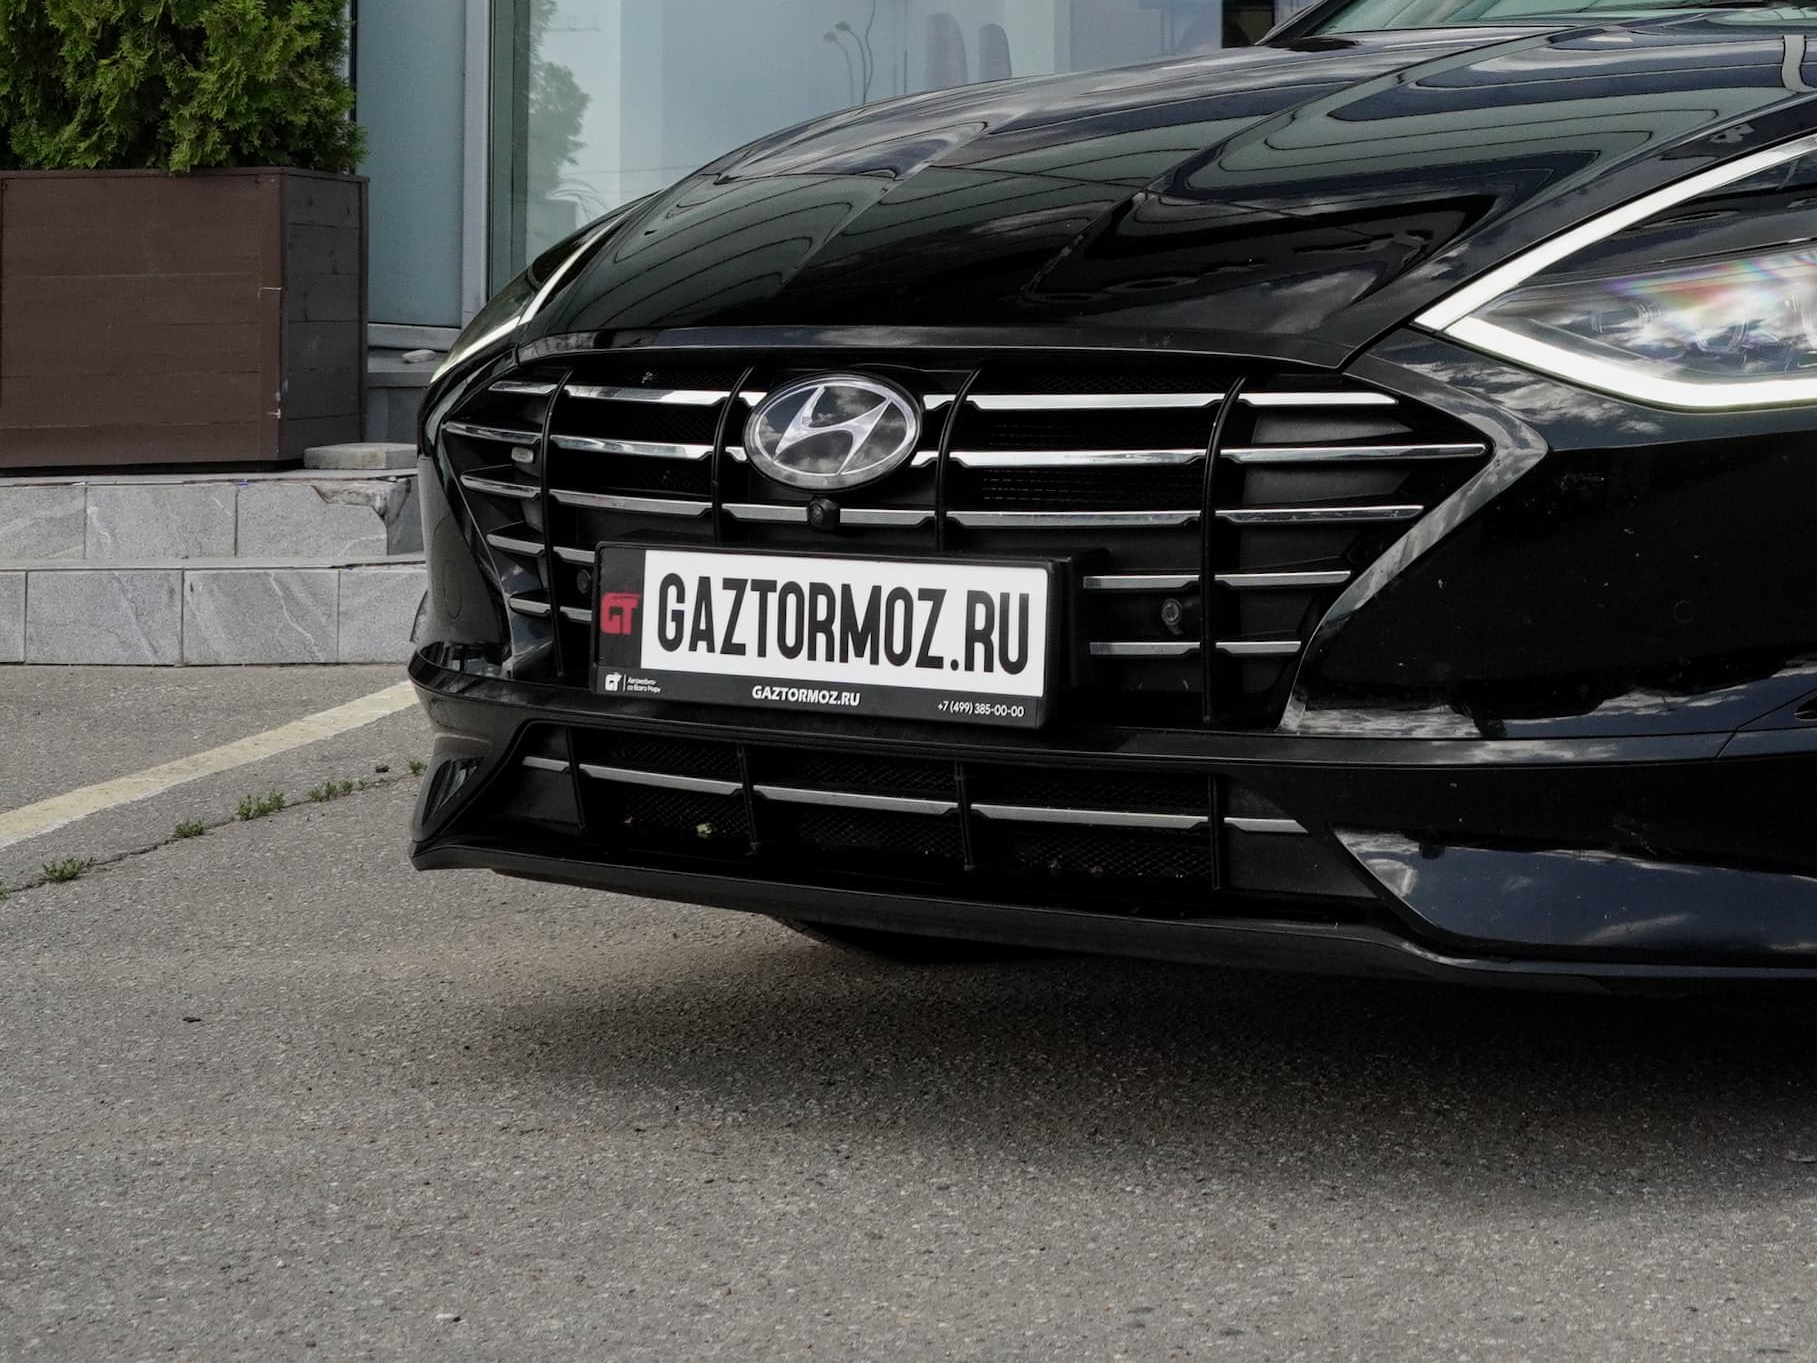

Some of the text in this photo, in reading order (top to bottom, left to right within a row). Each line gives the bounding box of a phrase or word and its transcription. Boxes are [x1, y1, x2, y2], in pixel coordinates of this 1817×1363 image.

[657, 572, 1029, 675] GAZTORMOZ.RU
[752, 685, 860, 706] GAZTORMOZ.RU
[938, 700, 1024, 717] +7 (499) 385-00-00
